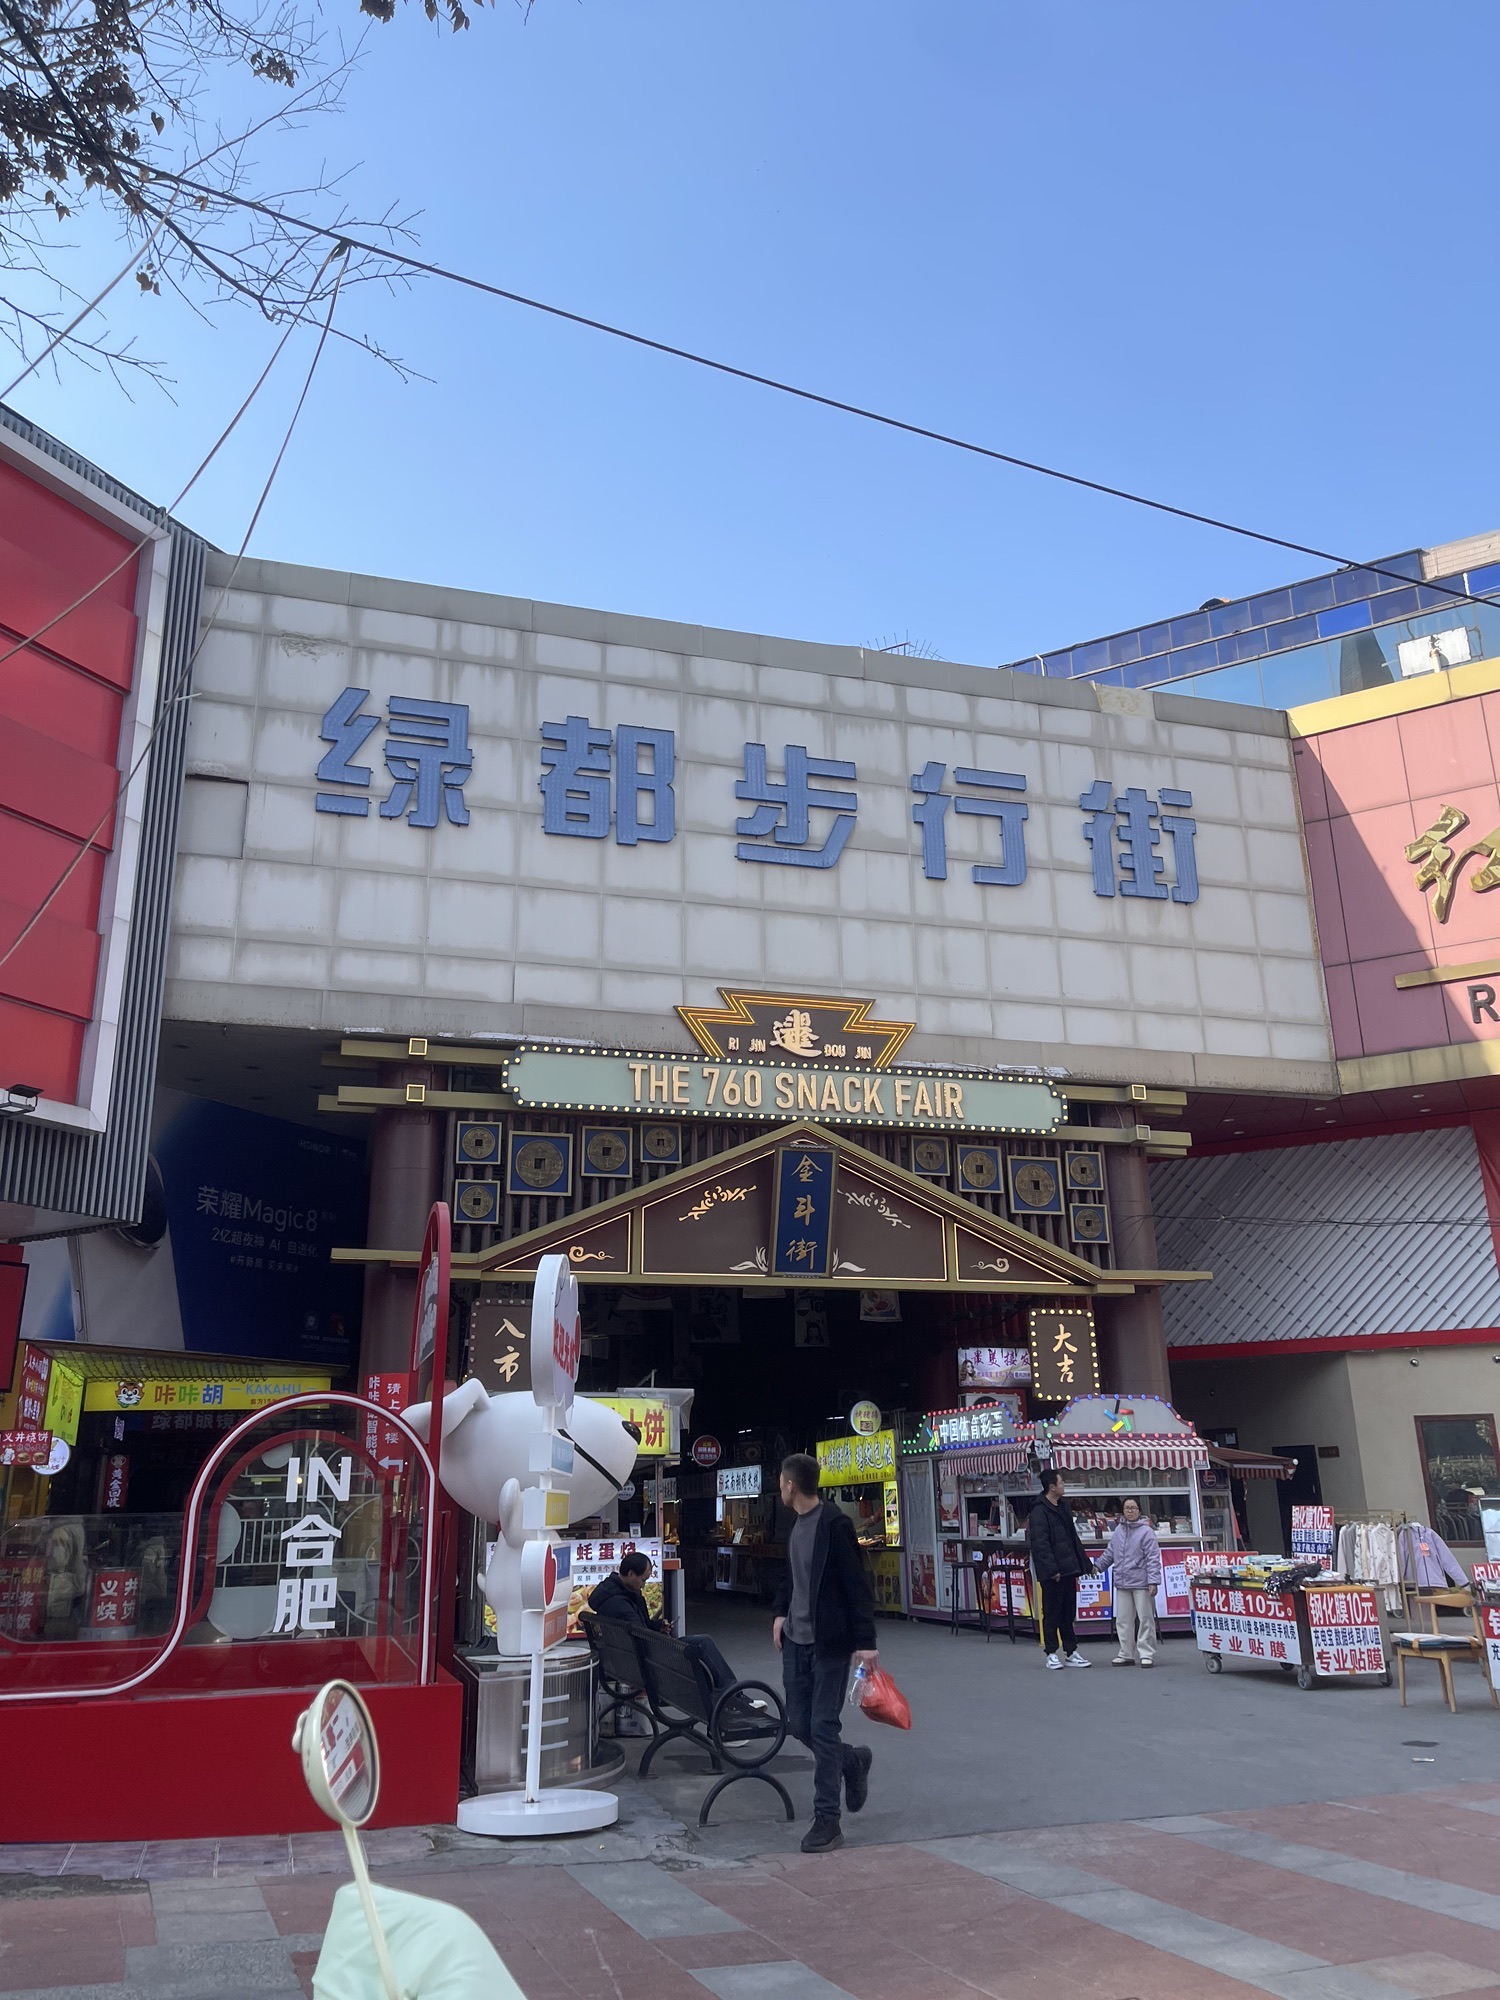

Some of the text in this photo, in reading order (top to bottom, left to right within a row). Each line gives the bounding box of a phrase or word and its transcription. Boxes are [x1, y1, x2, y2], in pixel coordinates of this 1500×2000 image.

[315, 687, 1199, 904] 绿都步行街
[728, 1037, 766, 1052] RI JIN
[824, 1044, 872, 1060] DOU JIN
[628, 1062, 965, 1119] THE 760 SNACK FAIR
[196, 1185, 318, 1232] 荣耀Magic8
[785, 1154, 823, 1270] 金斗街
[212, 1227, 318, 1258] 2亿超夜神 AI 自进化
[493, 1318, 526, 1383] 入市
[1052, 1323, 1078, 1383] 大吉
[154, 1383, 302, 1406] 咔咔胡 KAKAHU
[151, 1411, 241, 1431] 绿都眼镜
[384, 1383, 401, 1444] 请上楼
[939, 1411, 1003, 1444] 中国体育彩票
[106, 1468, 124, 1508] 黄金回收
[285, 1456, 352, 1503] IN
[576, 1541, 637, 1561] 蚝蛋烧
[99, 1577, 138, 1597] 义井
[272, 1514, 342, 1633] 合肥
[1309, 1592, 1379, 1625] 钢化膜10元。
[1208, 1632, 1288, 1660] 专业贴膜
[1316, 1647, 1384, 1673] 专业贴膜
